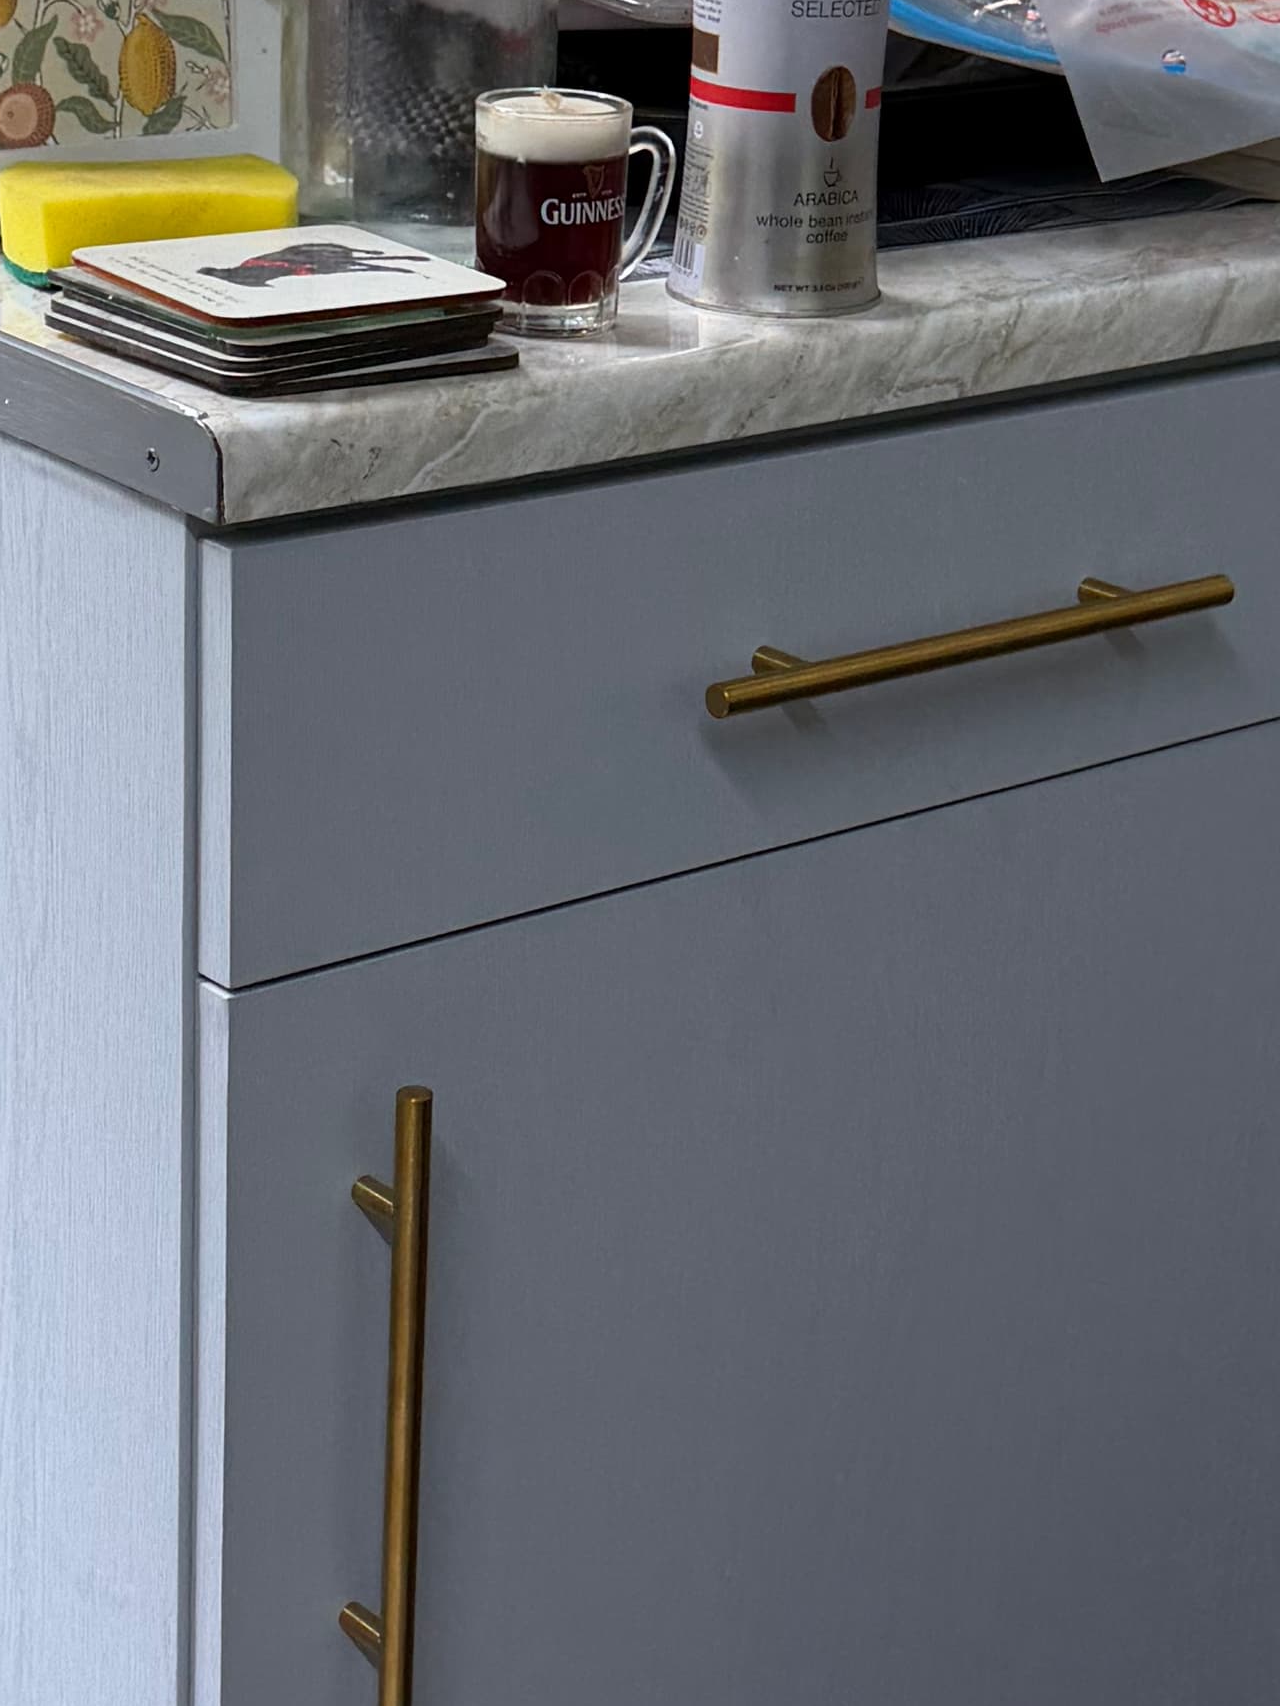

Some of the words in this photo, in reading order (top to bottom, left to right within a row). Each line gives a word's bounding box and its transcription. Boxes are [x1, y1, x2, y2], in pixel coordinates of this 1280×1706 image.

[793, 190, 859, 207] ARABICA
[756, 213, 803, 229] whole
[808, 213, 843, 228] bean
[806, 229, 848, 244] coffee
